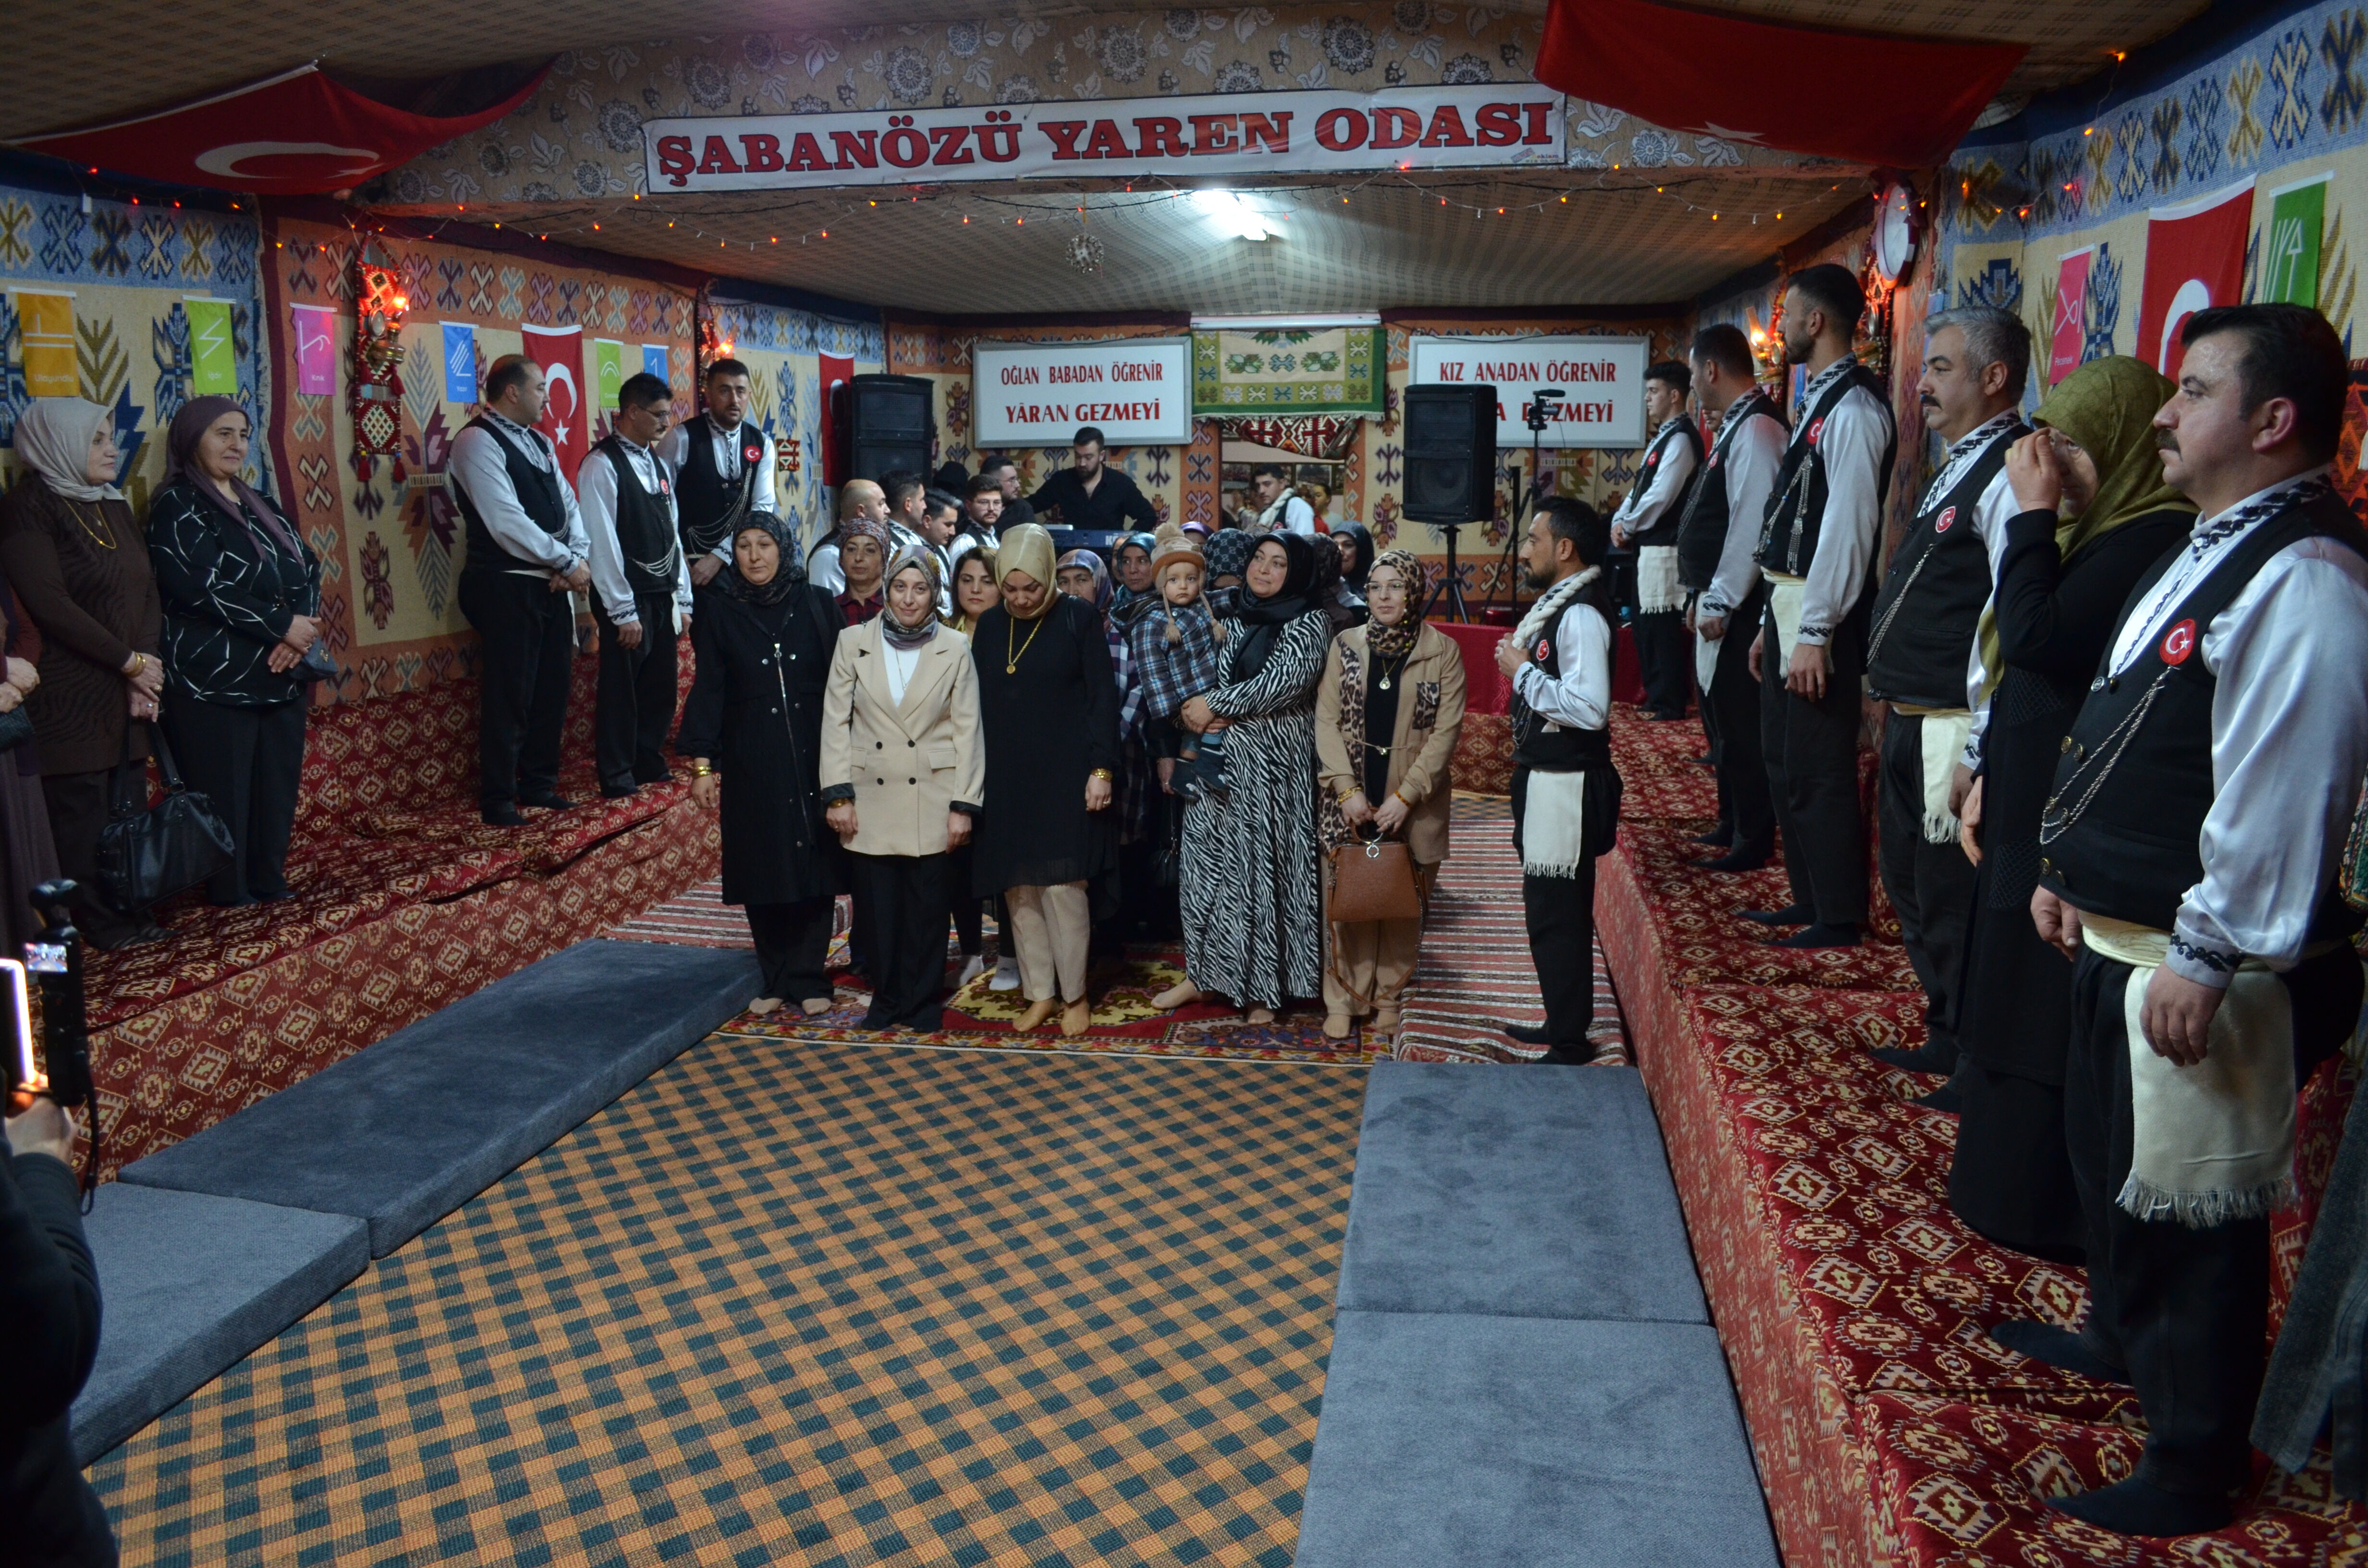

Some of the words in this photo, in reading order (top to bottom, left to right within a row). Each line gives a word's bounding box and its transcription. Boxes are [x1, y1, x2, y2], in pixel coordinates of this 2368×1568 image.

[656, 110, 1022, 187] ŞABANÖZÜ
[1038, 111, 1294, 159] YAREN
[1315, 102, 1554, 152] ODASI
[1001, 365, 1039, 385] OĞLAN
[1049, 365, 1103, 383] BABADAN
[1111, 359, 1162, 382] ÖĞRENİR
[1440, 362, 1464, 381] KIZ
[1475, 362, 1539, 381] ANADAN
[1547, 359, 1616, 382] ÖĞRENİR
[1005, 402, 1069, 423] YÂRAN
[1075, 398, 1159, 422] GEZMEYİ
[1522, 399, 1613, 422] DZMEYİ
